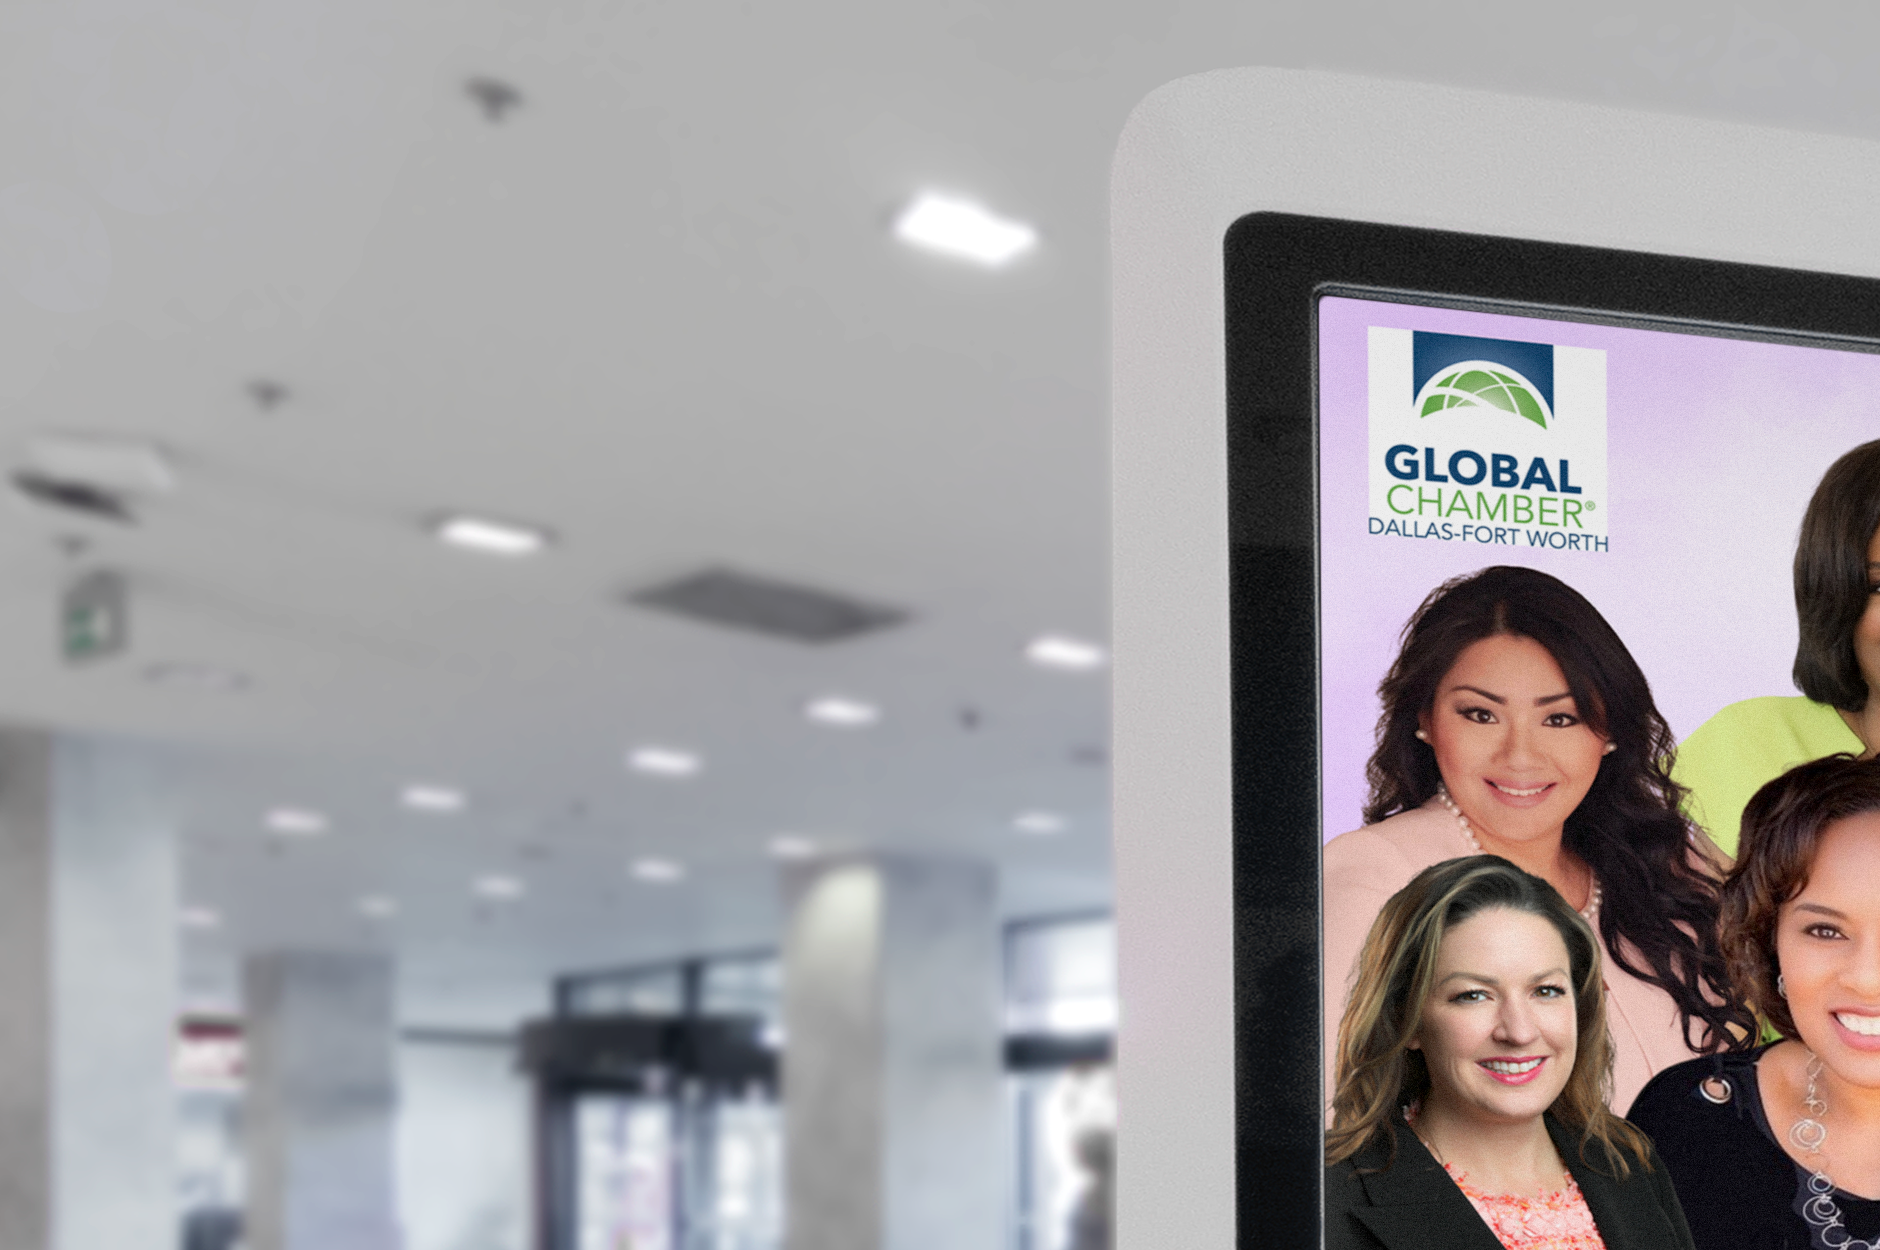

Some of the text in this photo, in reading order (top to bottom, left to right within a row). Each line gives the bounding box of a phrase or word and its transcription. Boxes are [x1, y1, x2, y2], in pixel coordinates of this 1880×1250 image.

[1385, 444, 1582, 494] GLOBAL
[1369, 517, 1608, 552] DALLAS-FORT WORTH
